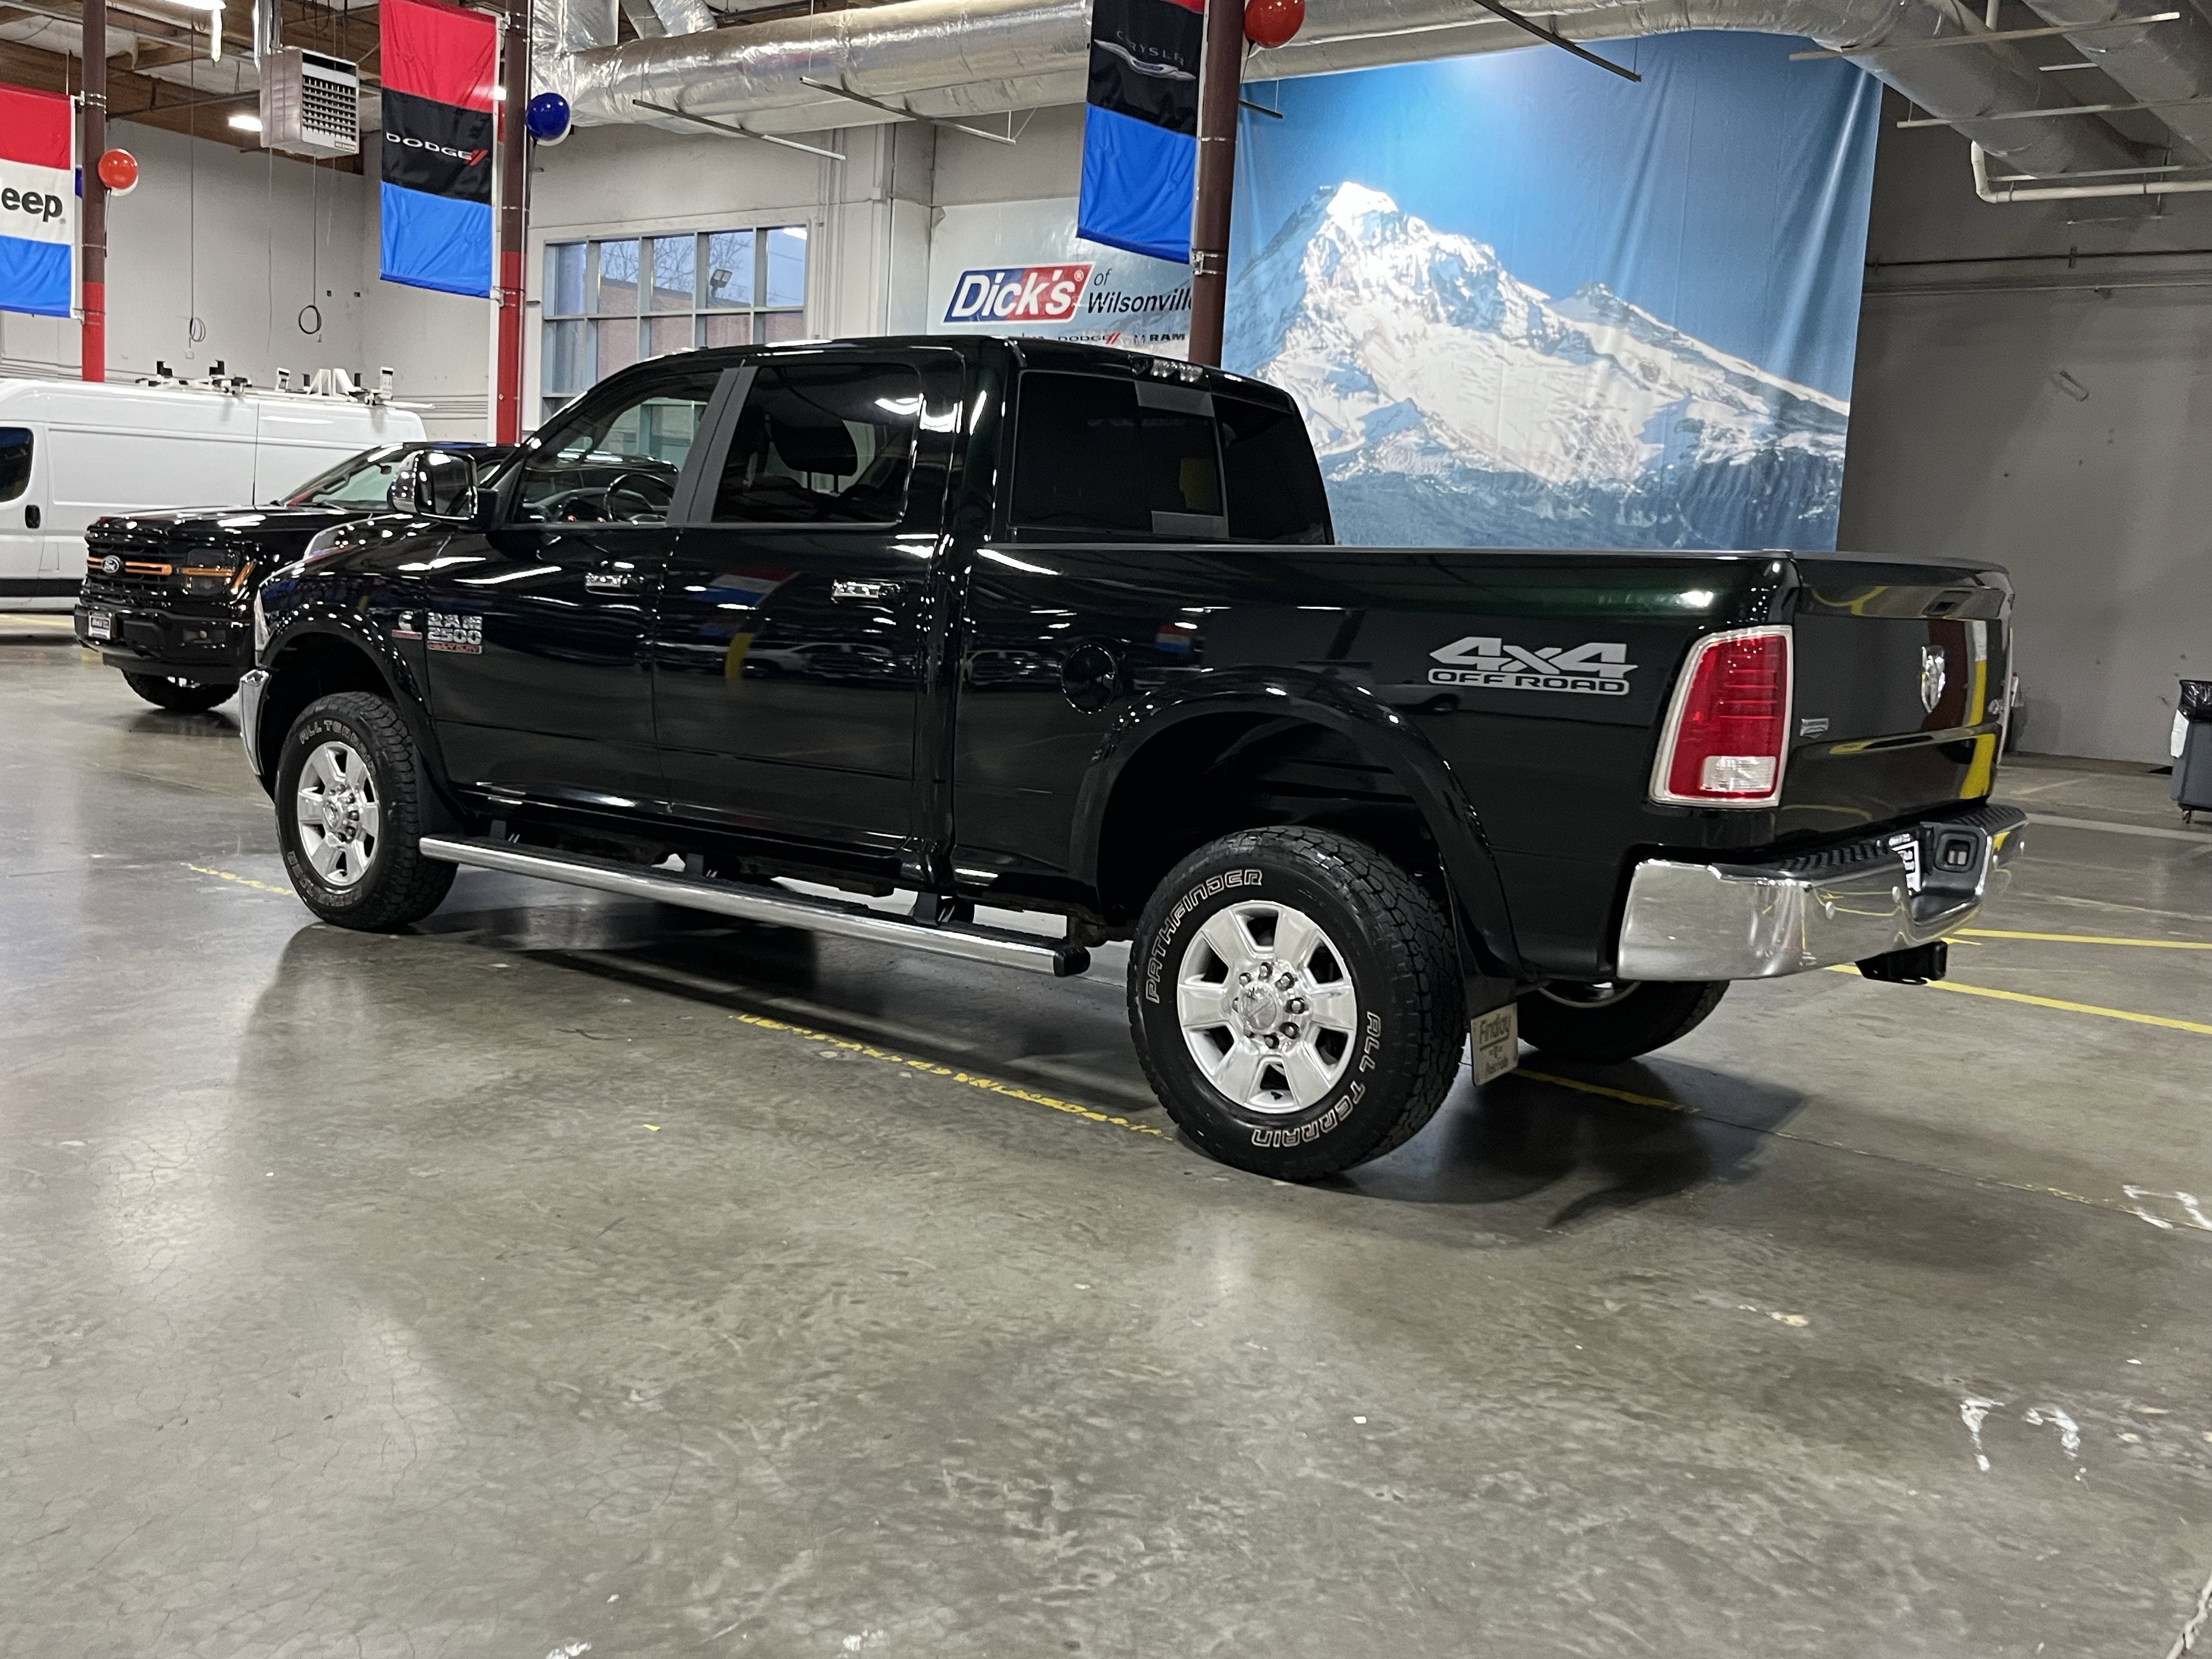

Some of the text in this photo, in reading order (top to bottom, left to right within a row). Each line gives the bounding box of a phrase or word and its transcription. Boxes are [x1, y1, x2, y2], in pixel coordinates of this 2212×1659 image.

[1116, 31, 1184, 66] CRYSLER
[386, 131, 472, 161] DODGE
[1, 187, 63, 223] eep
[1093, 268, 1113, 286] of
[951, 269, 1076, 318] Dick's
[1149, 332, 1186, 342] RAM
[428, 612, 483, 630] RAM
[427, 627, 482, 645] 2500
[1432, 670, 1625, 693] OFF ROAD
[300, 721, 323, 745] ALL
[1146, 868, 1262, 1003] PATHFINDER
[1251, 1011, 1382, 1148] ALL TERRAIN
